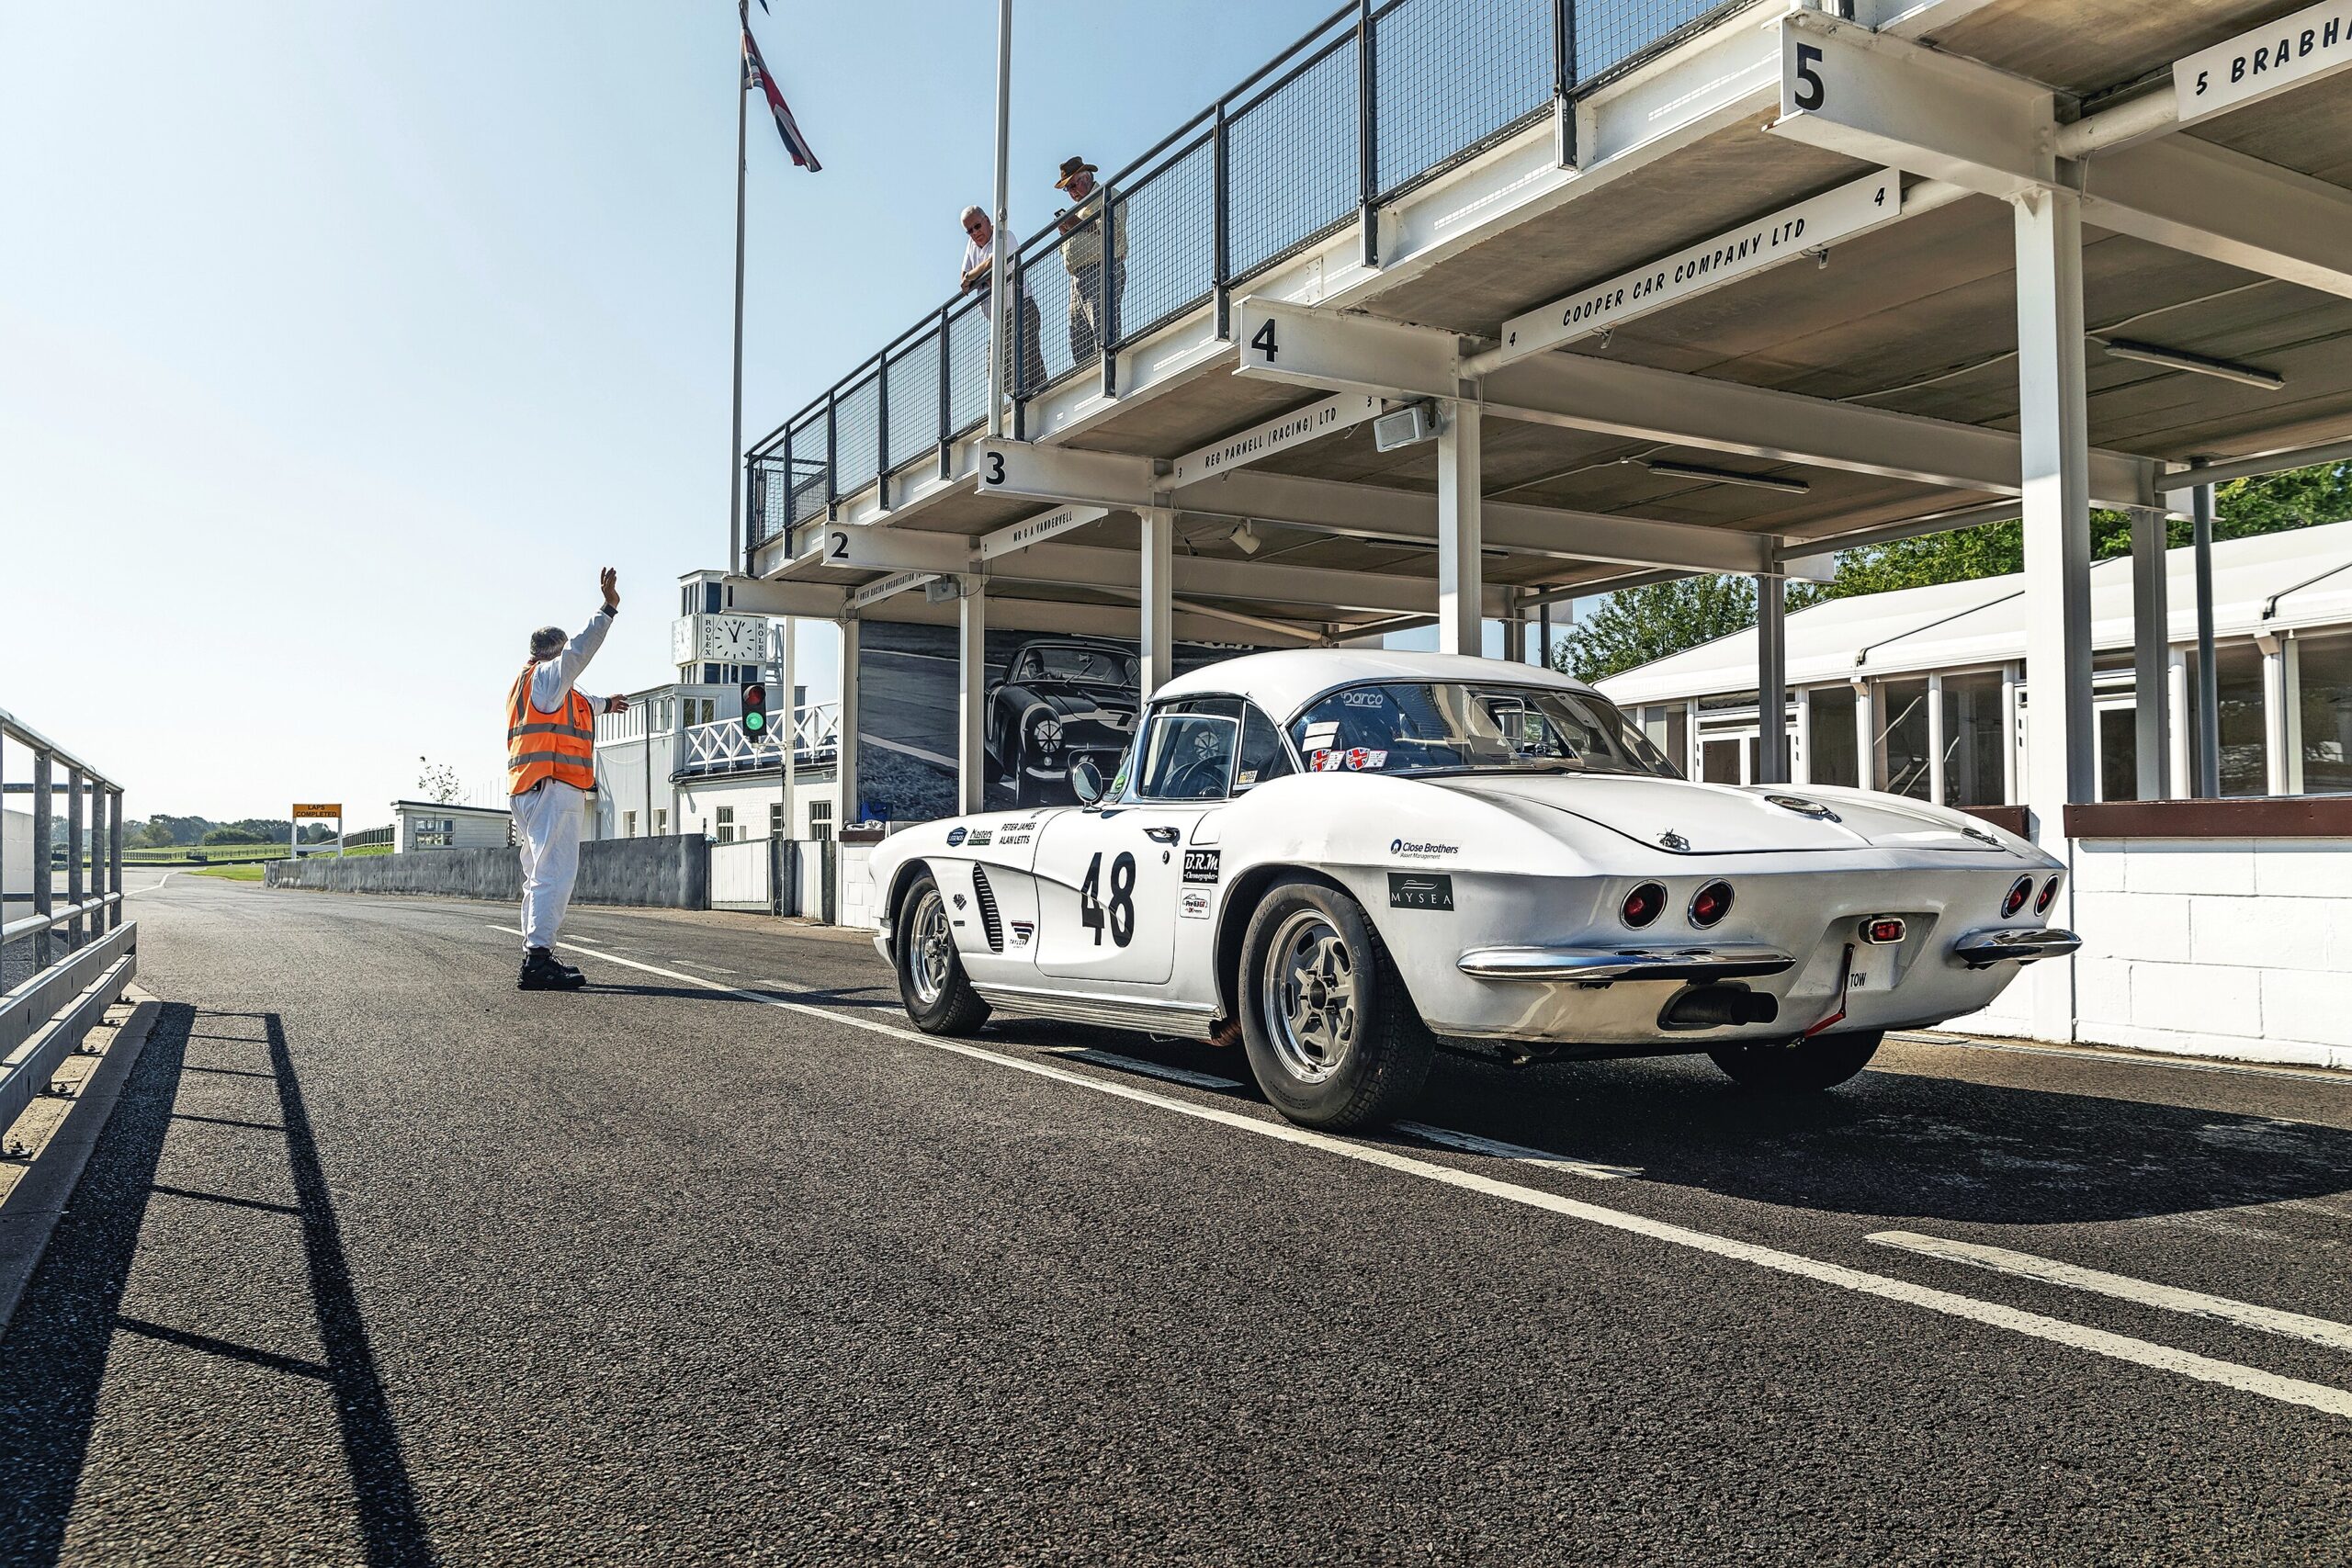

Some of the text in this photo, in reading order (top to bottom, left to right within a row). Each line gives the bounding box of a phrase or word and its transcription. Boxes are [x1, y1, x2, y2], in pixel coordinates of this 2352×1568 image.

[1794, 42, 1825, 111] 5
[2196, 71, 2209, 96] 5
[1509, 187, 1885, 347] 4 COOPER CAR COMPANY LTD 4
[1250, 318, 1279, 363] 4
[1178, 468, 1183, 479] 3
[1204, 450, 1221, 469] REG
[1225, 434, 1263, 461] PARNELL
[1268, 414, 1314, 448] (RACING)
[1319, 407, 1338, 426] LTD
[986, 451, 1007, 486] 3
[1013, 533, 1022, 543] MR
[1023, 528, 1029, 538] G
[1030, 526, 1035, 537] A
[1035, 511, 1073, 534] VANDERVELL
[831, 532, 849, 559] 2
[870, 583, 885, 597] RACING
[885, 572, 915, 592] ORGANISATION
[969, 828, 993, 839] Masters
[1001, 822, 1037, 831] PETER JAMES
[999, 835, 1031, 845] ALAN LETTS
[1402, 841, 1459, 854] Close Brothers
[1080, 851, 1136, 948] 48
[1390, 892, 1453, 905] MYSEA
[1849, 972, 1867, 987] TOW
